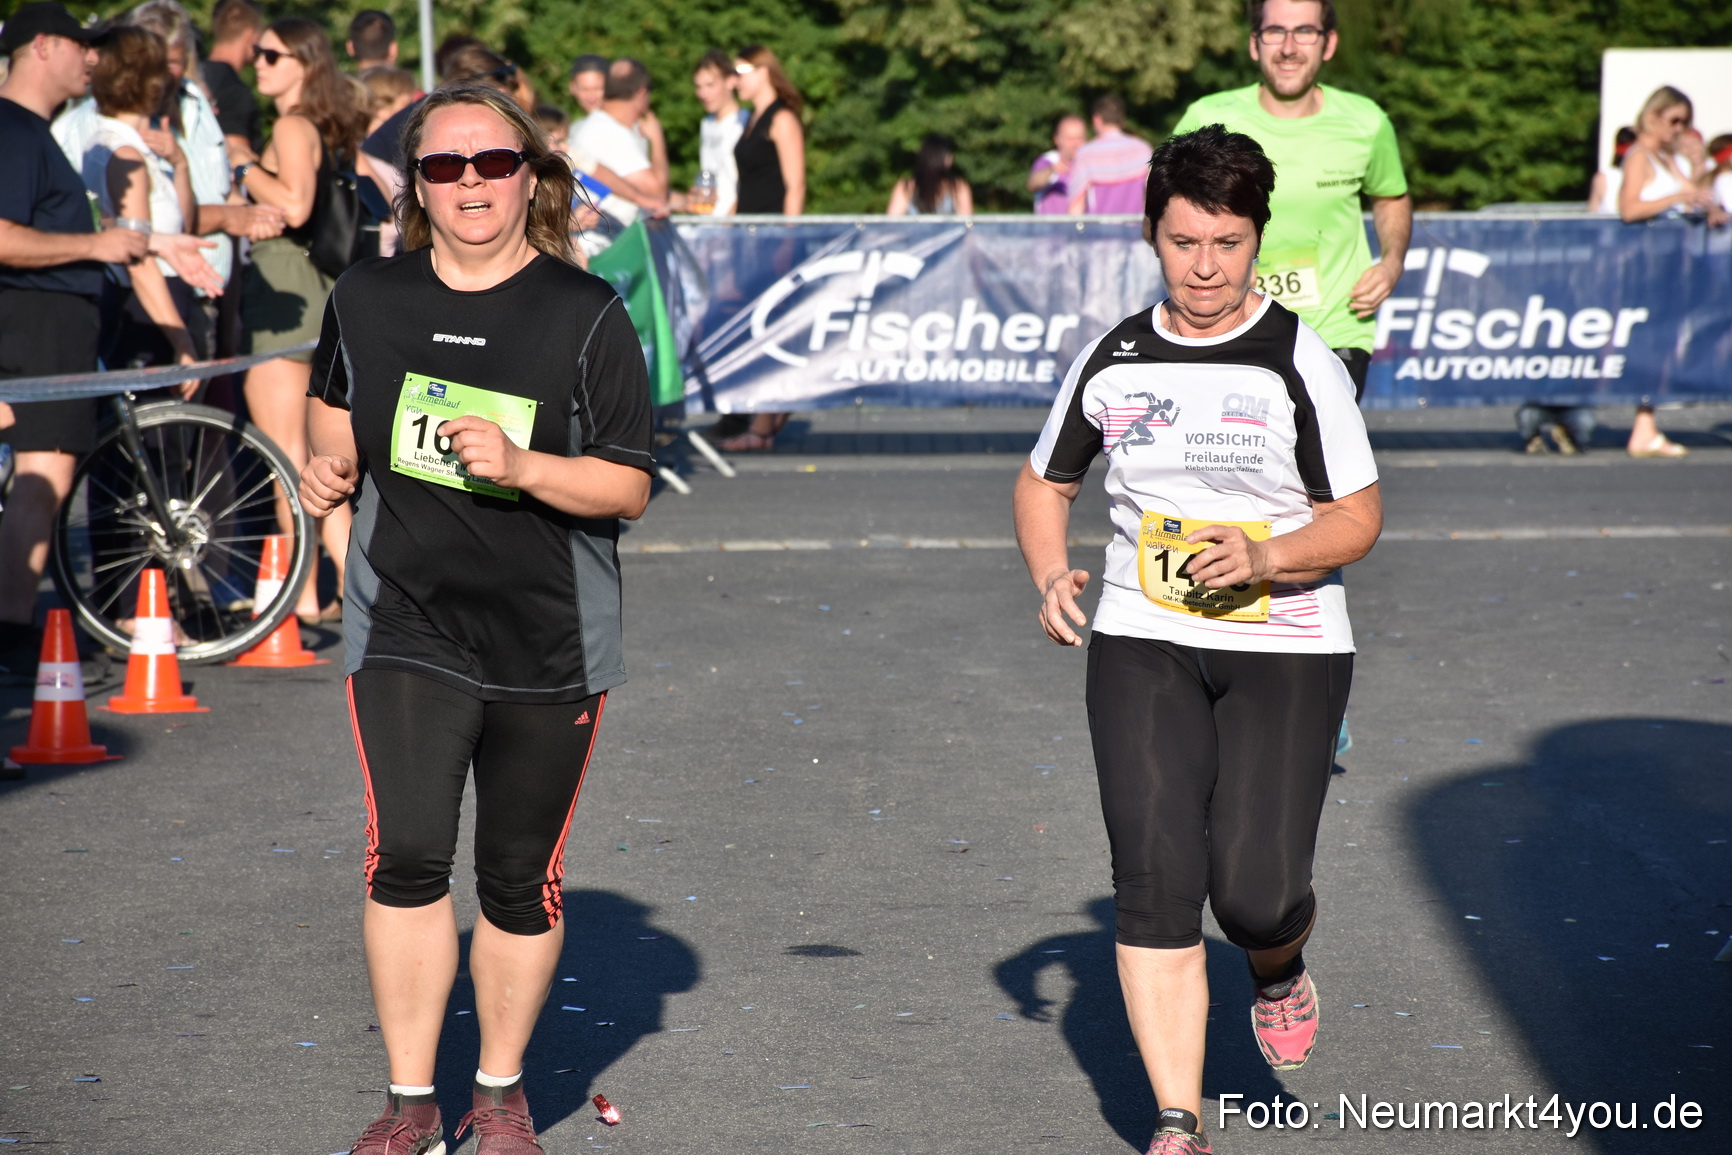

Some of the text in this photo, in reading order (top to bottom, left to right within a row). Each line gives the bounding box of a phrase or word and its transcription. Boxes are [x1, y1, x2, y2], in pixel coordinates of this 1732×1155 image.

[808, 297, 1080, 352] Fischer
[1373, 294, 1649, 350] Fischer
[433, 333, 486, 347] STANNO
[833, 357, 1056, 383] AUTOMOBILE
[1395, 354, 1627, 380] AUTOMOBILE
[416, 391, 461, 410] firmenlauf
[1222, 392, 1271, 418] OM
[1185, 433, 1266, 447] VORSICHT!
[398, 457, 420, 470] Regens
[421, 463, 445, 476] Wagner
[414, 451, 458, 471] Liebchen
[1184, 451, 1264, 464] Freilaufende
[1185, 465, 1264, 474] Klebebandspezialisten
[1169, 586, 1235, 603] Taubitz Karin
[1218, 602, 1241, 610] GmbH
